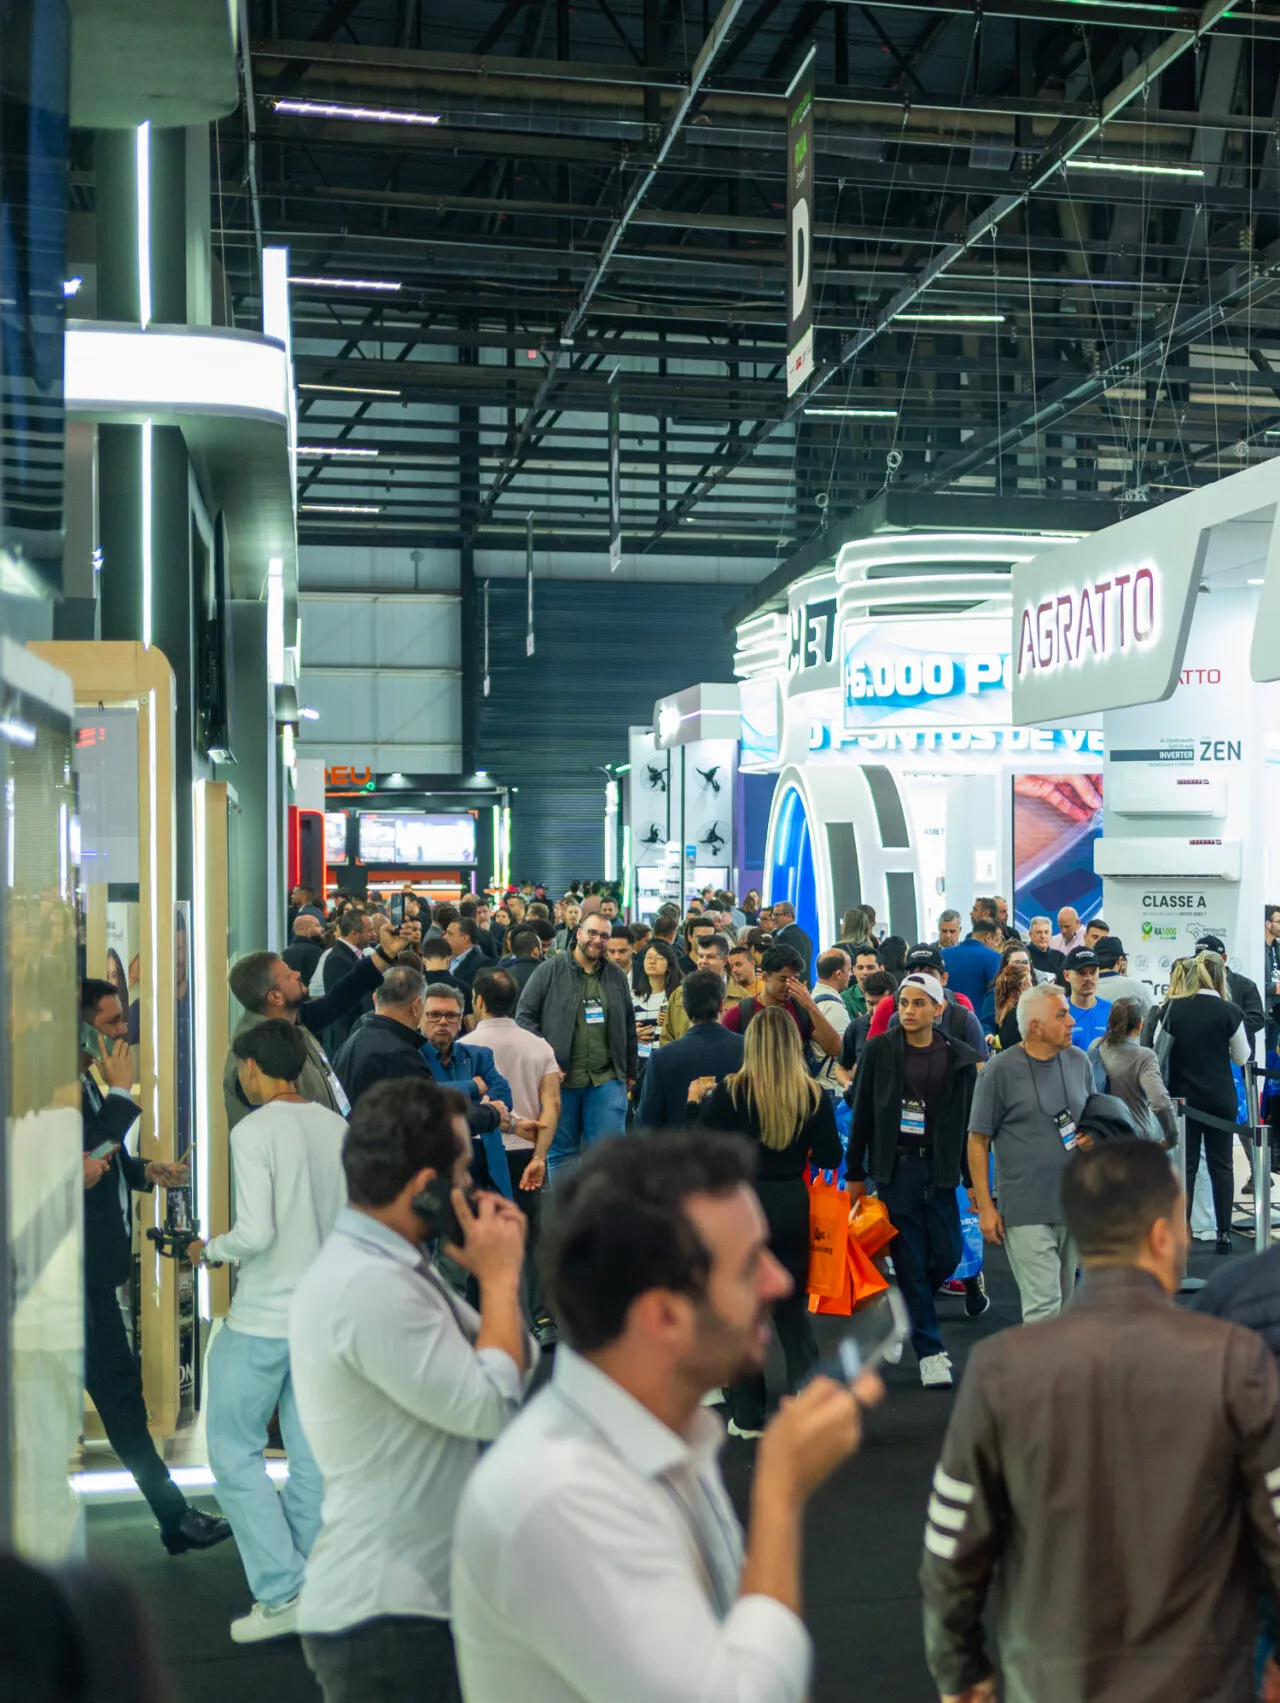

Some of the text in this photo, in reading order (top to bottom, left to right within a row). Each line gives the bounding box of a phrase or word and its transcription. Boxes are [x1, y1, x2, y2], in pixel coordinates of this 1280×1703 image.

[792, 198, 810, 322] D
[1017, 568, 1155, 675] AGRATTO
[846, 653, 954, 699] 6.000
[1159, 750, 1193, 759] INVERTER
[1199, 740, 1242, 761] ZEN
[1142, 895, 1207, 908] CLASSE A
